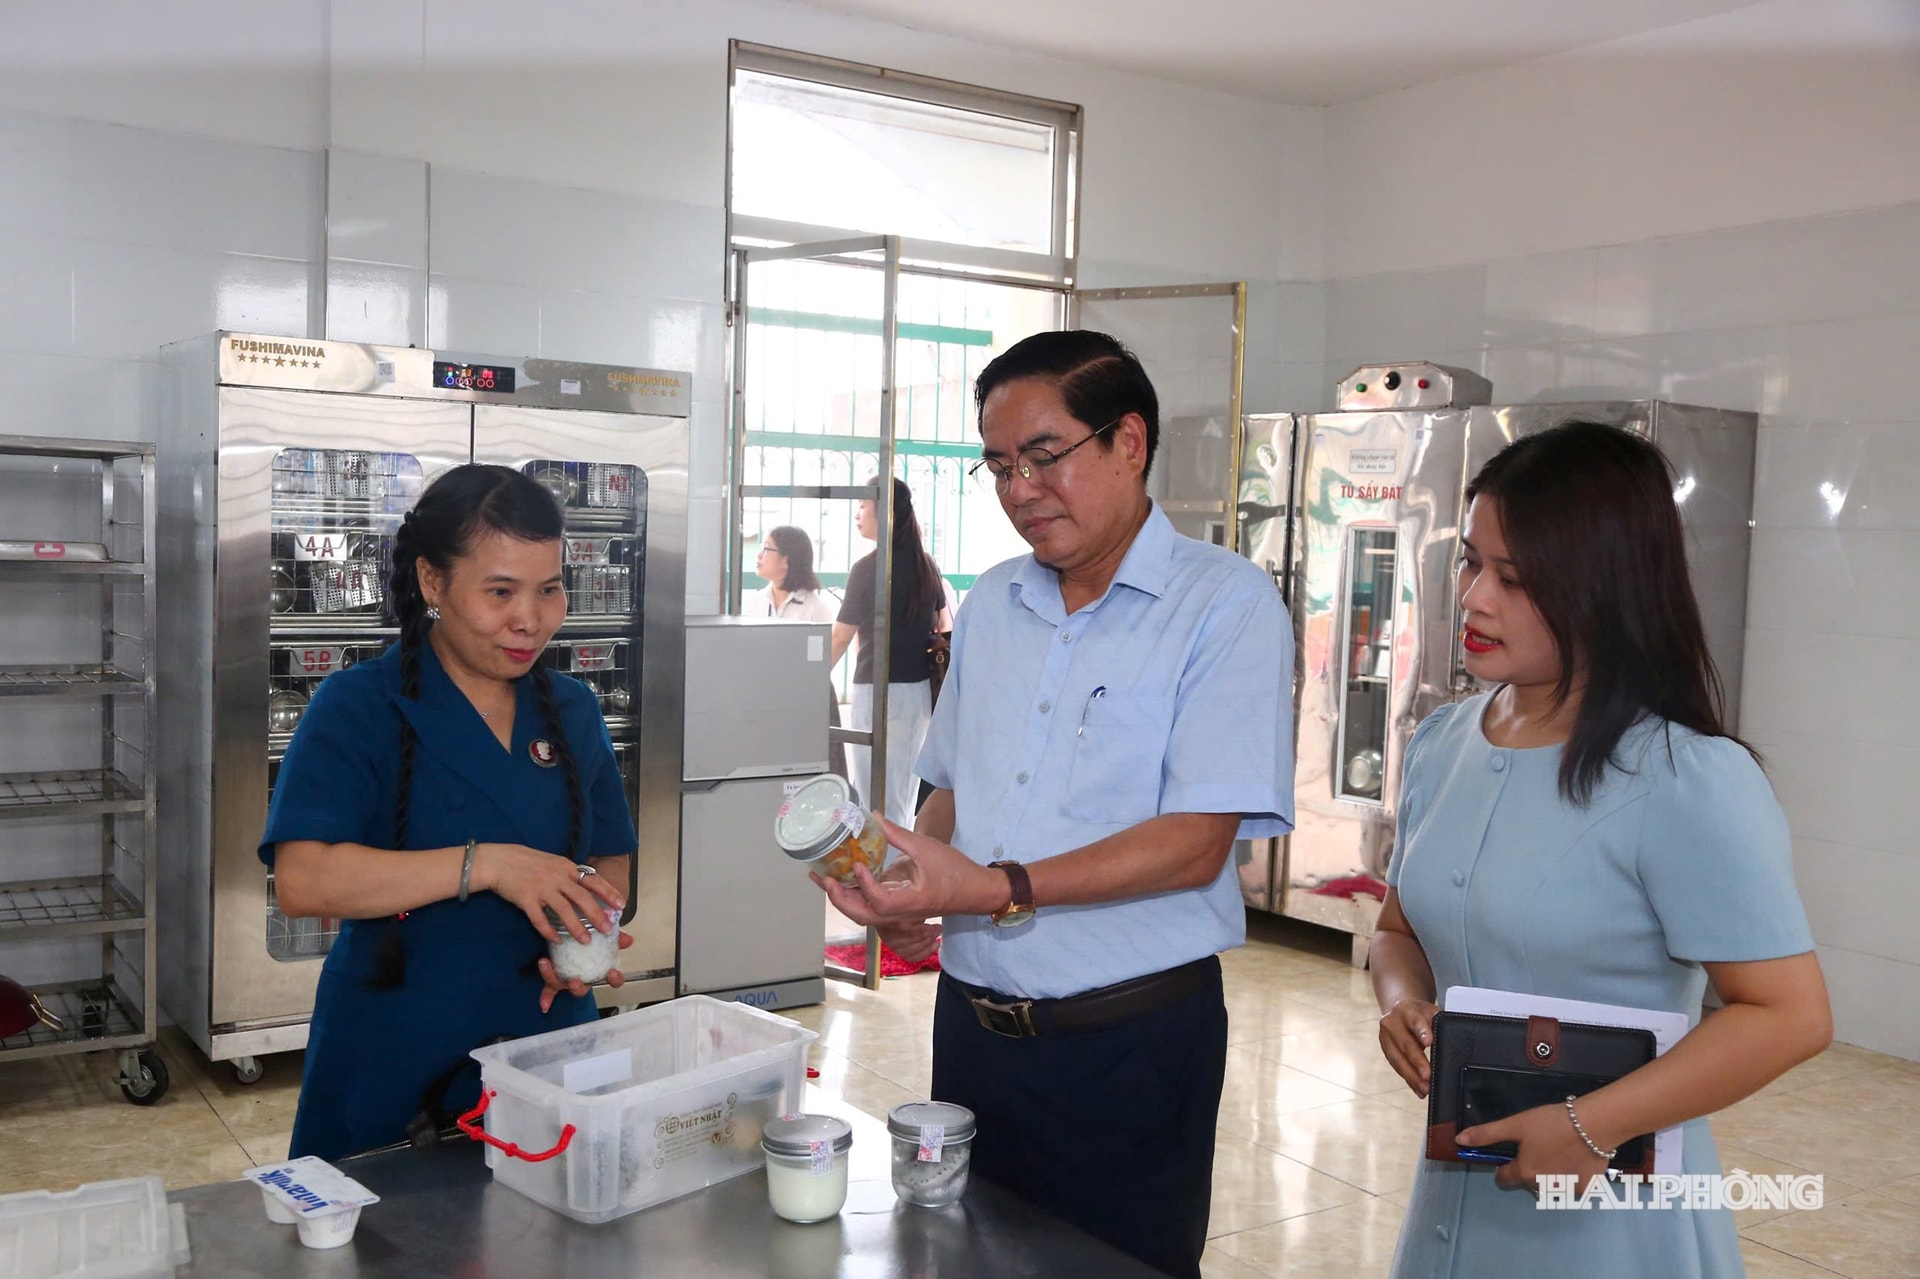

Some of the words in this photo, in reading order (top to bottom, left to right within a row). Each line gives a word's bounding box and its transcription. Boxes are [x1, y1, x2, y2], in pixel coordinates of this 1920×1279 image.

[230, 339, 326, 359] FUSHIMAVINA
[606, 371, 682, 388] FUSHIMAVINA
[1341, 481, 1354, 498] TỦ
[1358, 480, 1378, 499] SẤY
[305, 536, 334, 557] 4A
[569, 541, 593, 562] 3A
[303, 650, 332, 672] 5B
[680, 1116, 699, 1130] VIỆT
[700, 1109, 722, 1124] NHẬT
